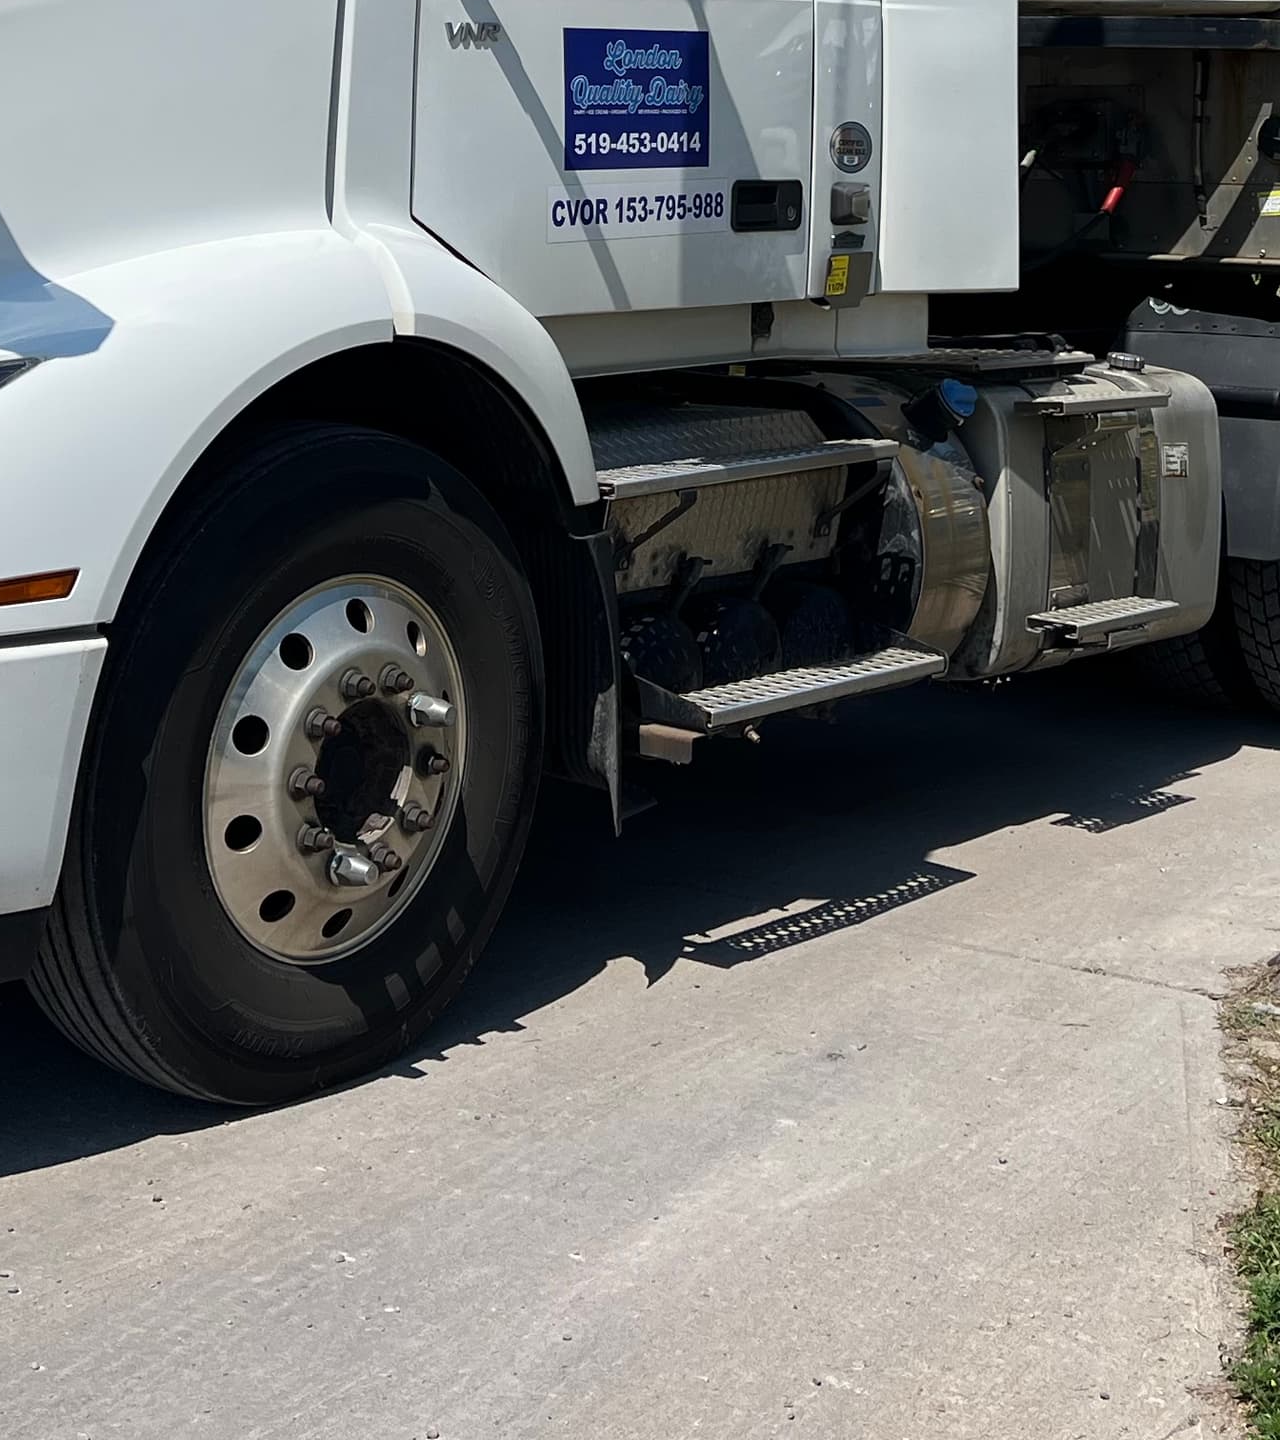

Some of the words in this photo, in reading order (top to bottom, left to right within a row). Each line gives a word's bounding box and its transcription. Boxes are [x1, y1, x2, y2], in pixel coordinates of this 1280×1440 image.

[444, 22, 500, 42] VNR
[604, 40, 682, 76] London
[571, 75, 644, 113] Quality
[645, 76, 704, 113] Dairy
[574, 132, 701, 155] 519-453-0414
[552, 198, 608, 227] CVOR
[615, 192, 724, 223] 153-795-988
